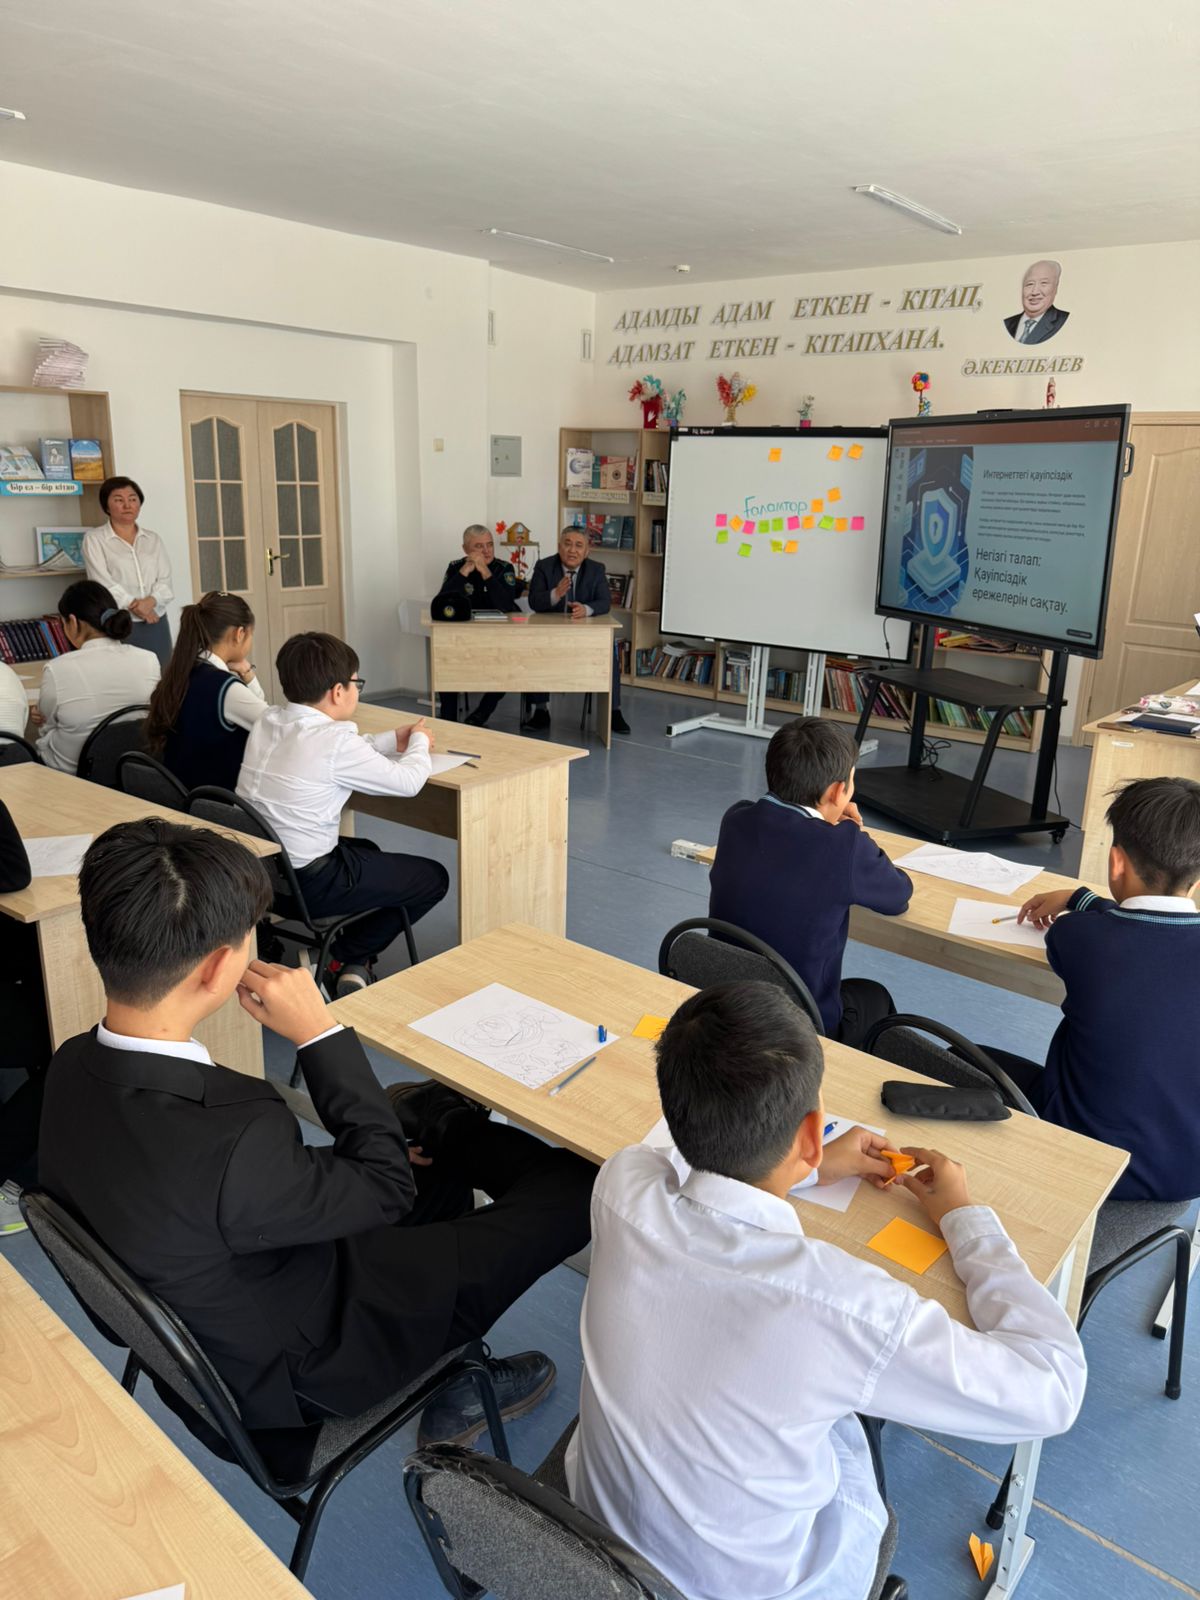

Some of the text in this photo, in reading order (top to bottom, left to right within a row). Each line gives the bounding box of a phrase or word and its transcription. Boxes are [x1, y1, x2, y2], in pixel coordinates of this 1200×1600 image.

[614, 305, 701, 331] АДАМДЫ
[711, 300, 774, 326] АДАМ
[793, 294, 872, 318] ЕТКЕН
[901, 285, 982, 311] КІТАП,
[608, 341, 695, 367] АДАМЗАТ
[708, 337, 780, 359] ЕТКЕН
[804, 328, 944, 354] КІТАПХАНА.
[963, 357, 1083, 375] Ә.КЕКІЛБАЕВ
[983, 469, 1073, 482] Интернеттегі қауіпсіздік
[976, 548, 1041, 566] Негізгі талап:
[974, 567, 1028, 586] Қауіпсіздік
[972, 588, 1068, 615] ережелерін сақтау.
